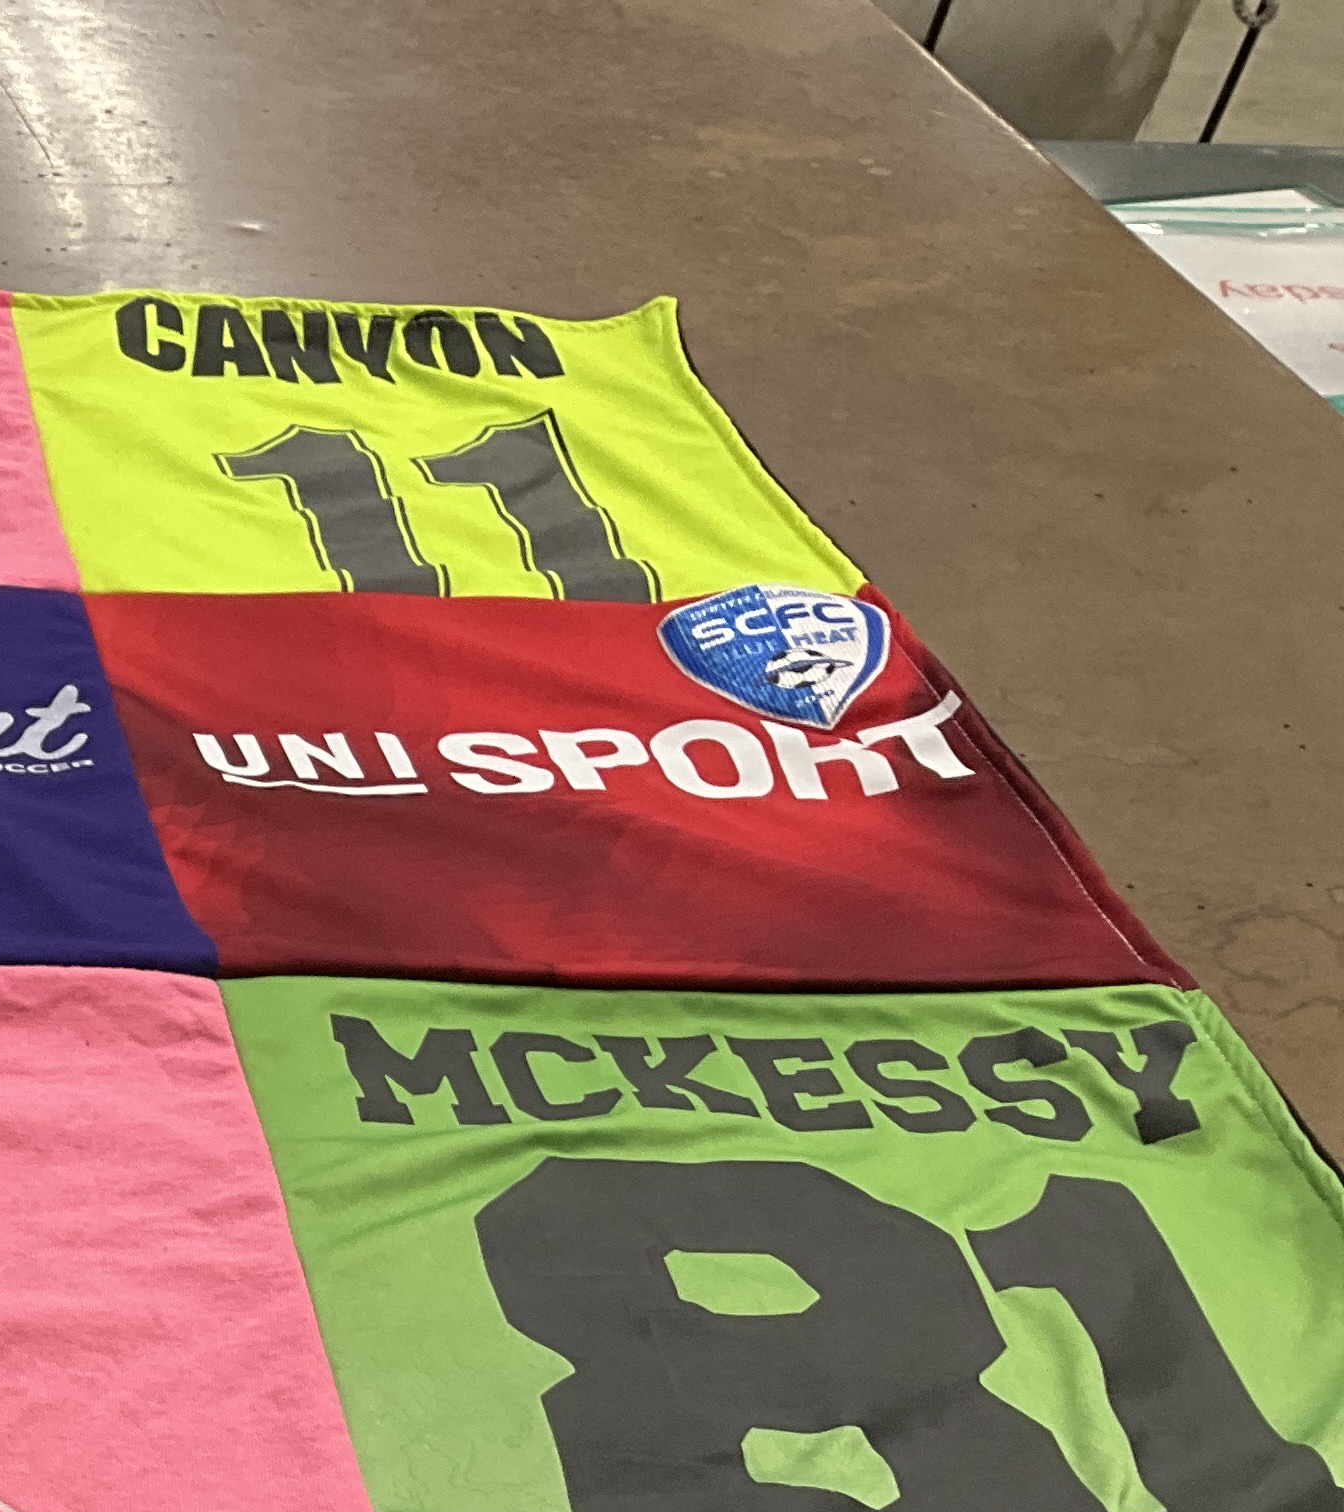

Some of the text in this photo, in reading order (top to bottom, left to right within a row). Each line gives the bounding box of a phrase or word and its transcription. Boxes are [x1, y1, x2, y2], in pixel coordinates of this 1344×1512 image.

[115, 294, 565, 385] CANYON
[213, 408, 663, 604] 11
[691, 602, 854, 651] SCFC
[791, 626, 857, 649] HEAT
[329, 1012, 1201, 1144] MCKESSY
